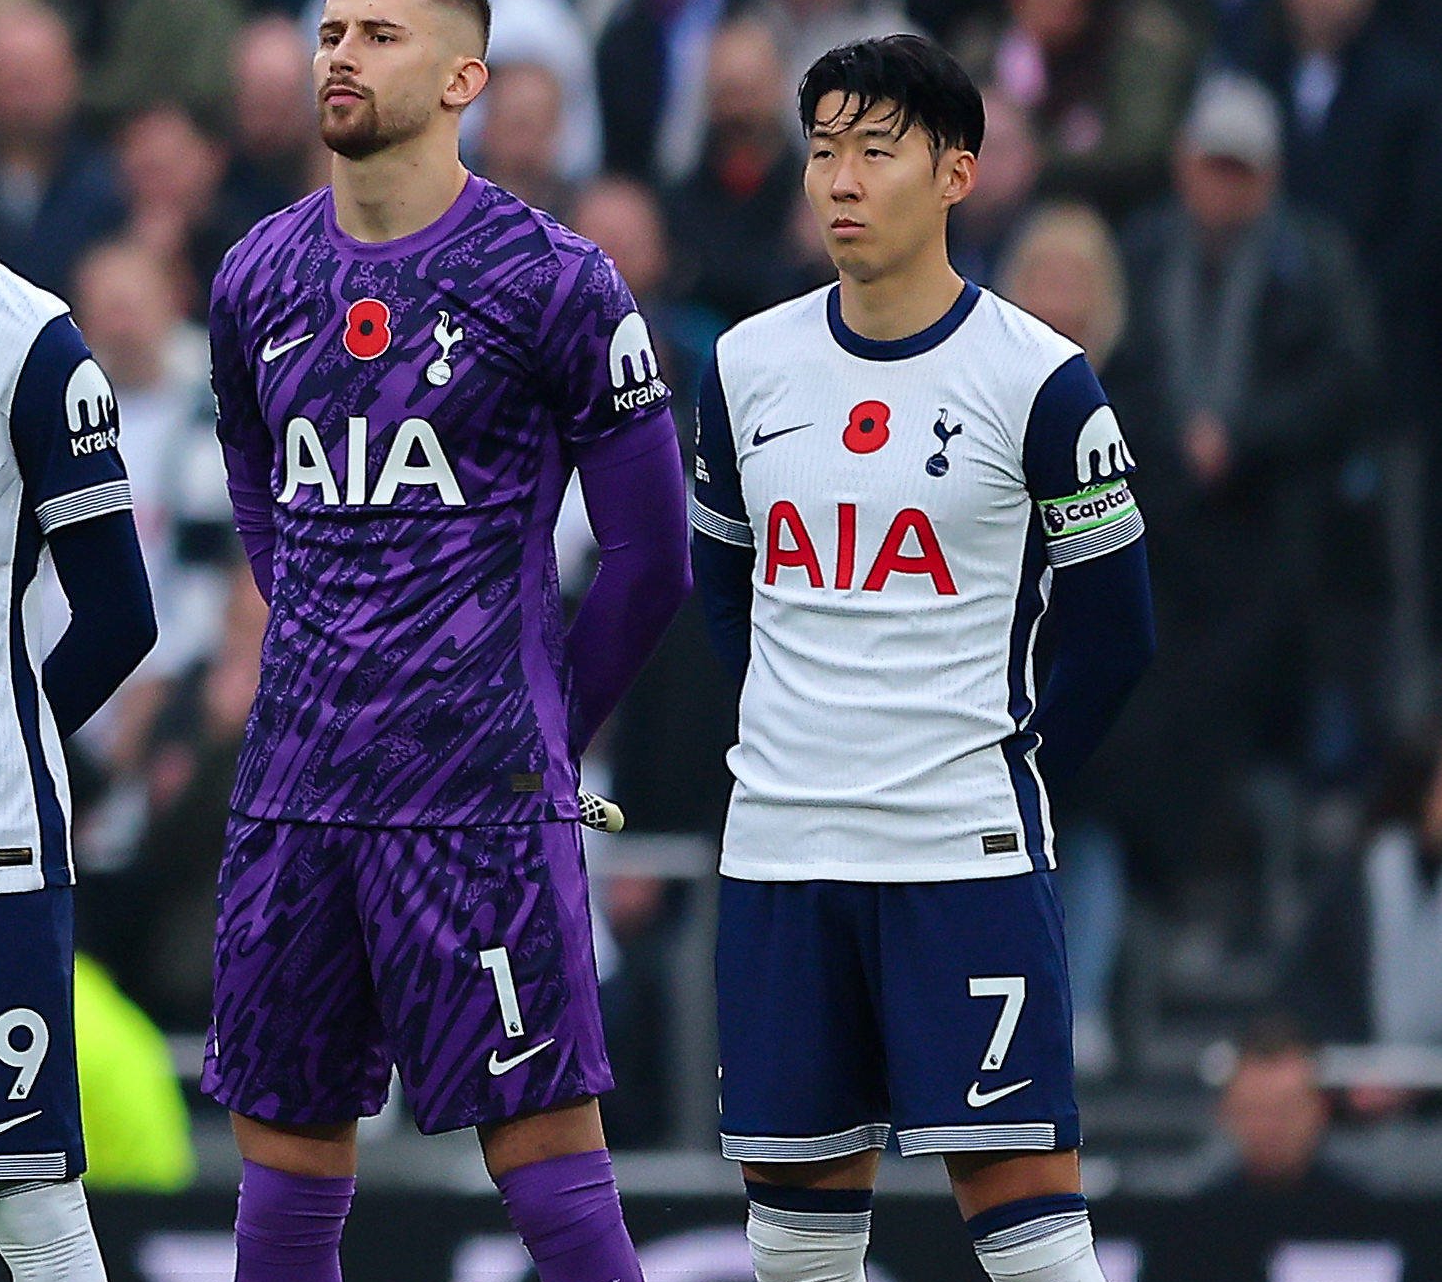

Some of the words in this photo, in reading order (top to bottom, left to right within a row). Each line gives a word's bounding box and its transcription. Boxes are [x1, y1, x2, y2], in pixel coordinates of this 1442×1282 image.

[277, 417, 466, 505] AIA
[767, 501, 956, 594] AIA
[480, 947, 524, 1037] 1
[969, 977, 1025, 1069] 7
